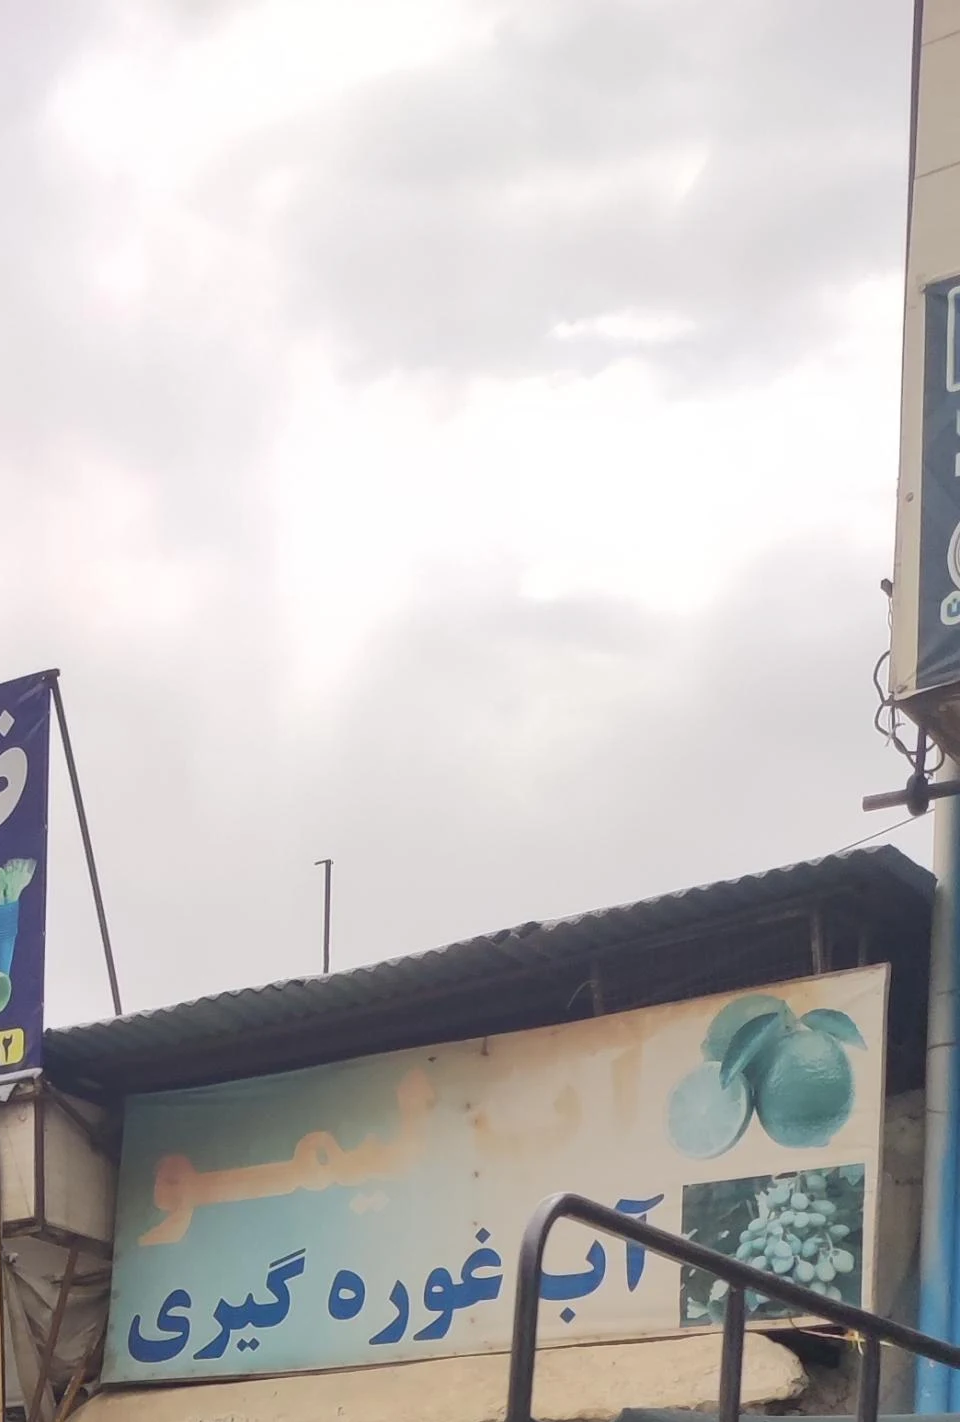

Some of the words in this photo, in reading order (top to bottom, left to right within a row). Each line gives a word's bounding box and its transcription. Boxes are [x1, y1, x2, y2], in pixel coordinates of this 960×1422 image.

[127, 1248, 305, 1363] گیری
[327, 1226, 504, 1345] غوره
[538, 1193, 665, 1323] آب
